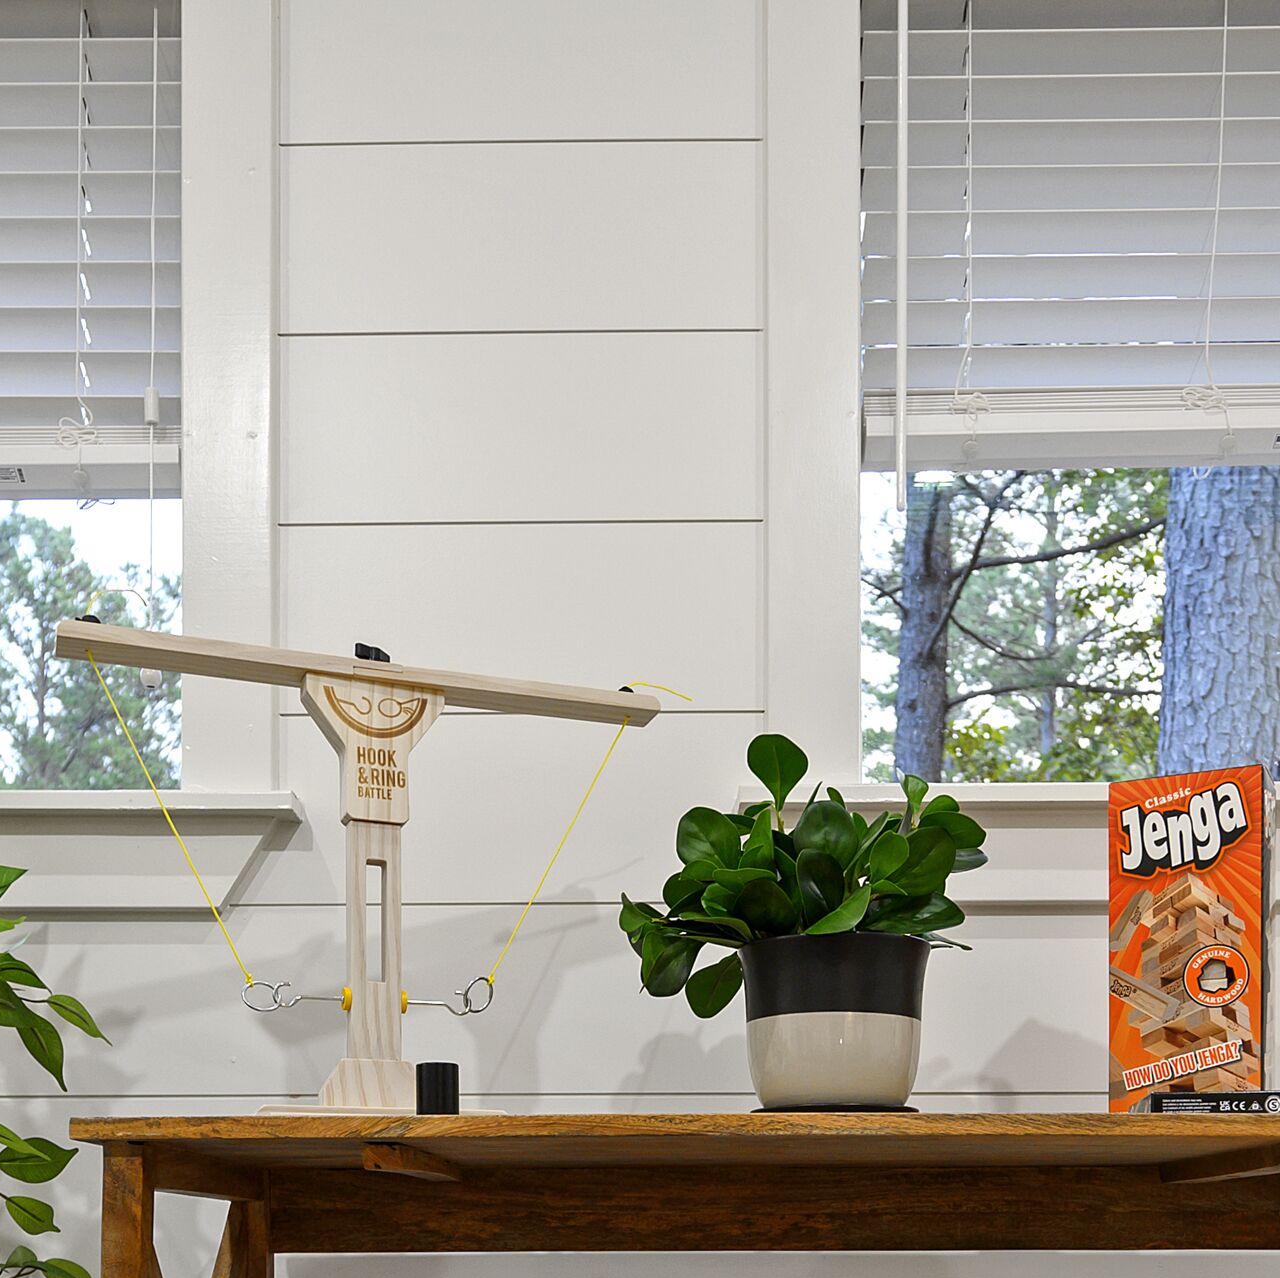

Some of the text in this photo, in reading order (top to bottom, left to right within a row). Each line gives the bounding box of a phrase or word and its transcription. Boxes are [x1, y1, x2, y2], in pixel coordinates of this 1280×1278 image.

[357, 746, 397, 768] HOOK
[358, 767, 406, 788] & RING
[358, 786, 393, 801] BATTLE
[1144, 787, 1192, 809] Classic
[1121, 782, 1247, 870] Jenga
[1192, 950, 1232, 969] GENUINE
[1197, 978, 1244, 1004] HARDWOOD
[1124, 1041, 1239, 1089] HOW DO YOU JENGA?
